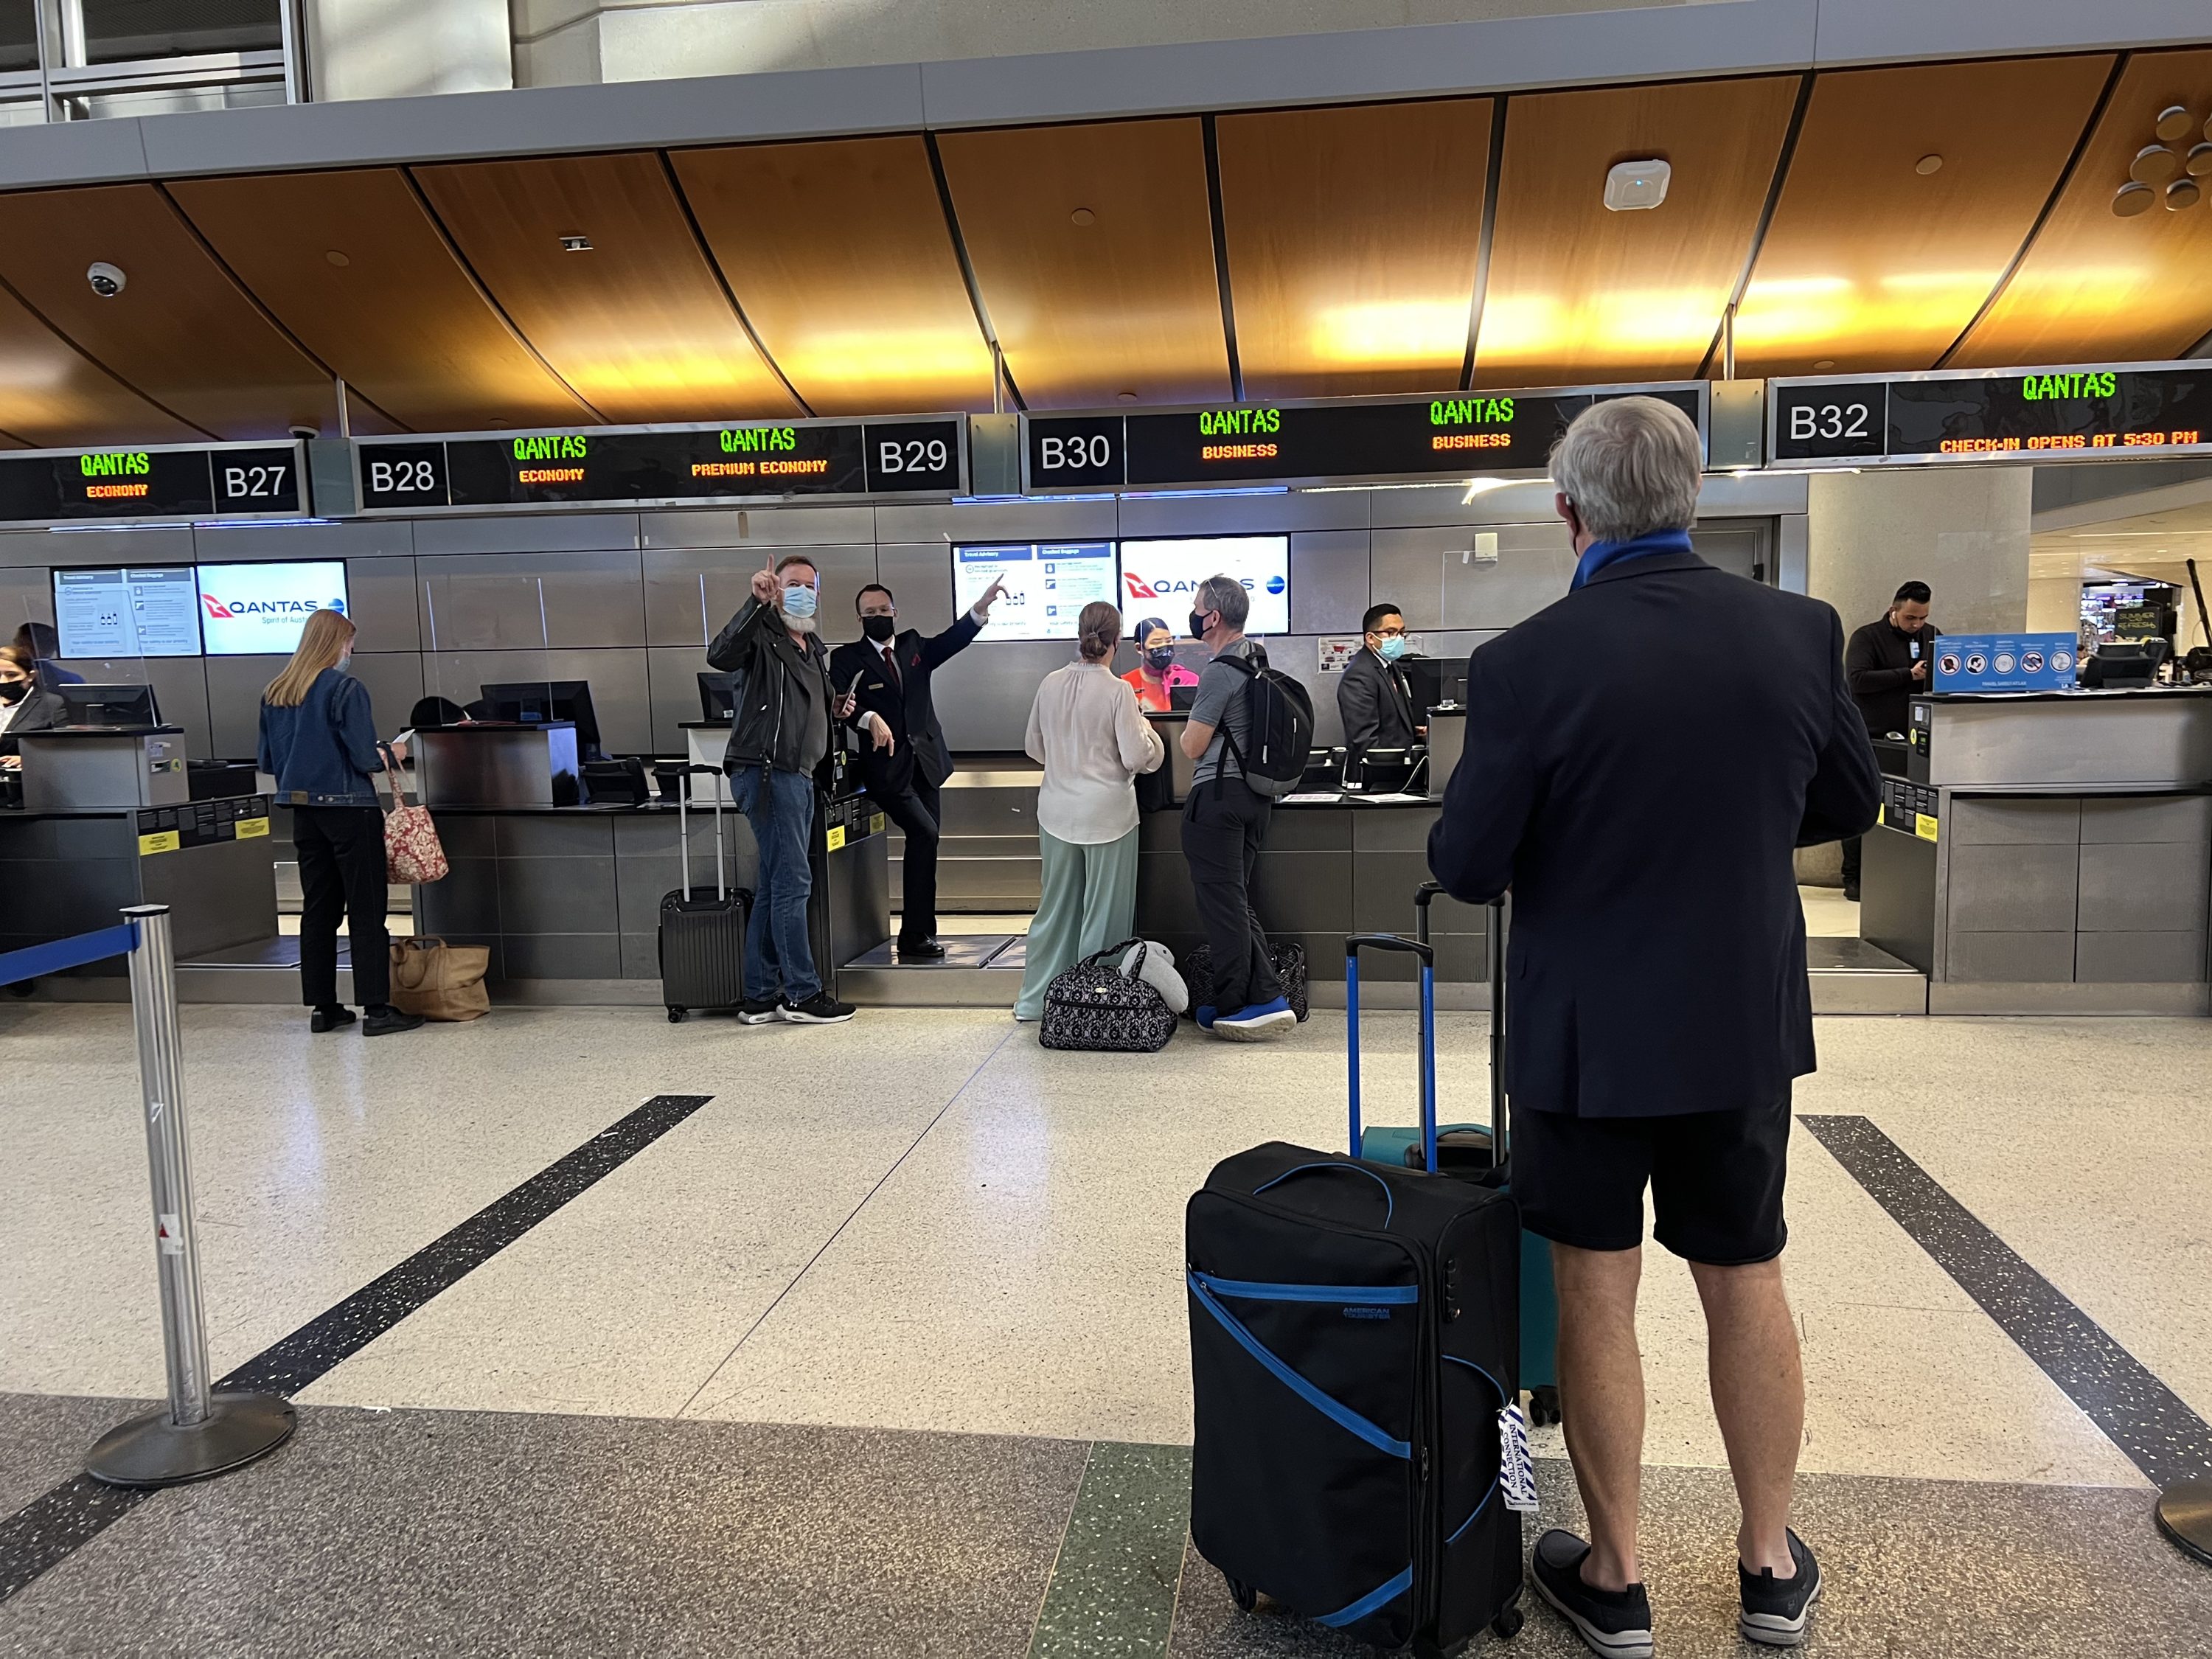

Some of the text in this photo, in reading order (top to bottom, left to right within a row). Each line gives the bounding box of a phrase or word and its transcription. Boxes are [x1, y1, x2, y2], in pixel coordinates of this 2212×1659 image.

[2023, 372, 2116, 400] QANTAS
[1200, 408, 1280, 435] QANTAS
[1430, 397, 1514, 425] QANTAS
[1791, 403, 1868, 439] B32
[514, 435, 587, 460] QANTAS
[720, 427, 796, 453] QANTAS
[1041, 435, 1110, 469] B30
[1203, 444, 1278, 459] BUSINESS
[1432, 434, 1511, 450] BUSINESS
[1940, 431, 2198, 453] CHECK-IN OPENS AT 5:30 PM
[80, 452, 149, 476] QANTAS
[691, 459, 828, 476] PREMIUM ECONOMY
[880, 440, 947, 473] B29
[225, 466, 287, 498] B27
[371, 461, 435, 493] B28
[518, 468, 585, 483] ECONOMY
[86, 484, 149, 498] ECONOMY
[1154, 578, 1255, 593] QANS
[229, 600, 319, 613] QANTAS
[262, 616, 279, 625] Spirit
[1503, 1433, 1517, 1488] CONNECTION
[1509, 1424, 1527, 1495] INTERNATIONAL
